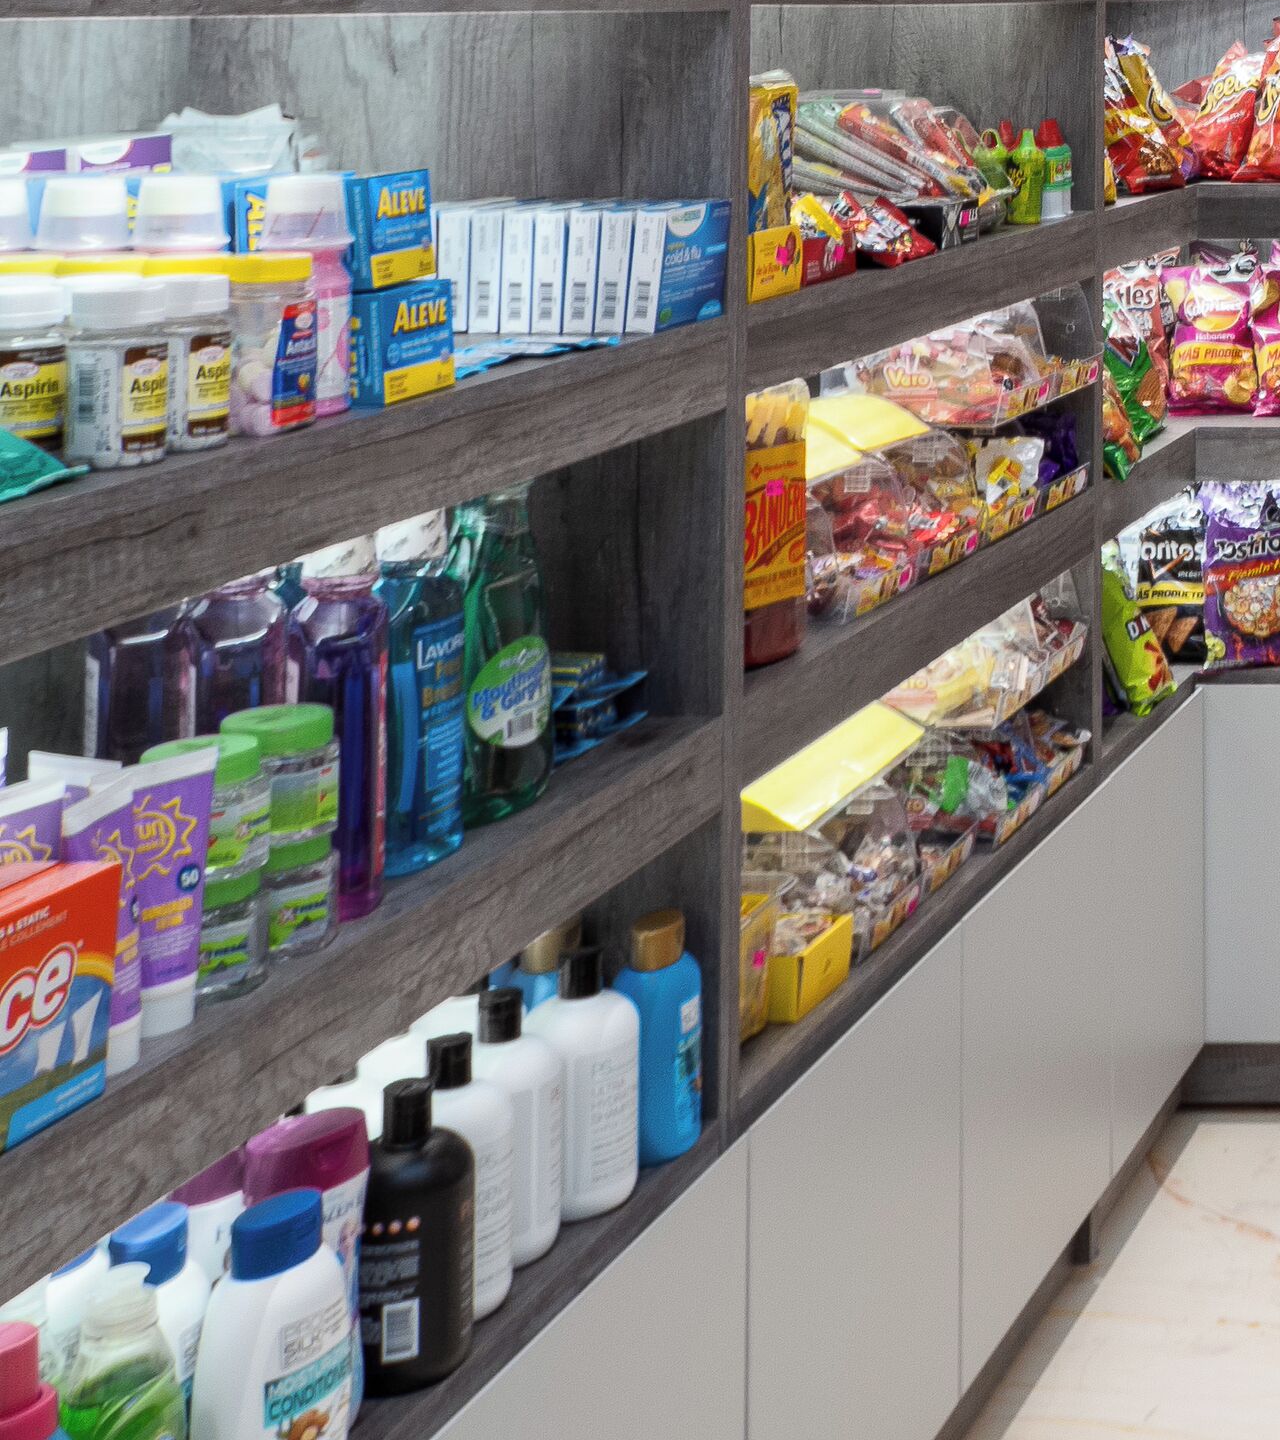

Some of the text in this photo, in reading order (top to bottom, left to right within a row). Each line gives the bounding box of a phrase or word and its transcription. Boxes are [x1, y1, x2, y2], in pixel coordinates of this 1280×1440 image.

[376, 186, 426, 221] ALEVE
[392, 297, 448, 336] ALEVE
[1204, 346, 1250, 360] PRODUCT
[0, 377, 60, 400] Aspirin
[1142, 541, 1205, 562] oritos
[417, 632, 465, 671] LAVOR
[180, 871, 199, 888] 50
